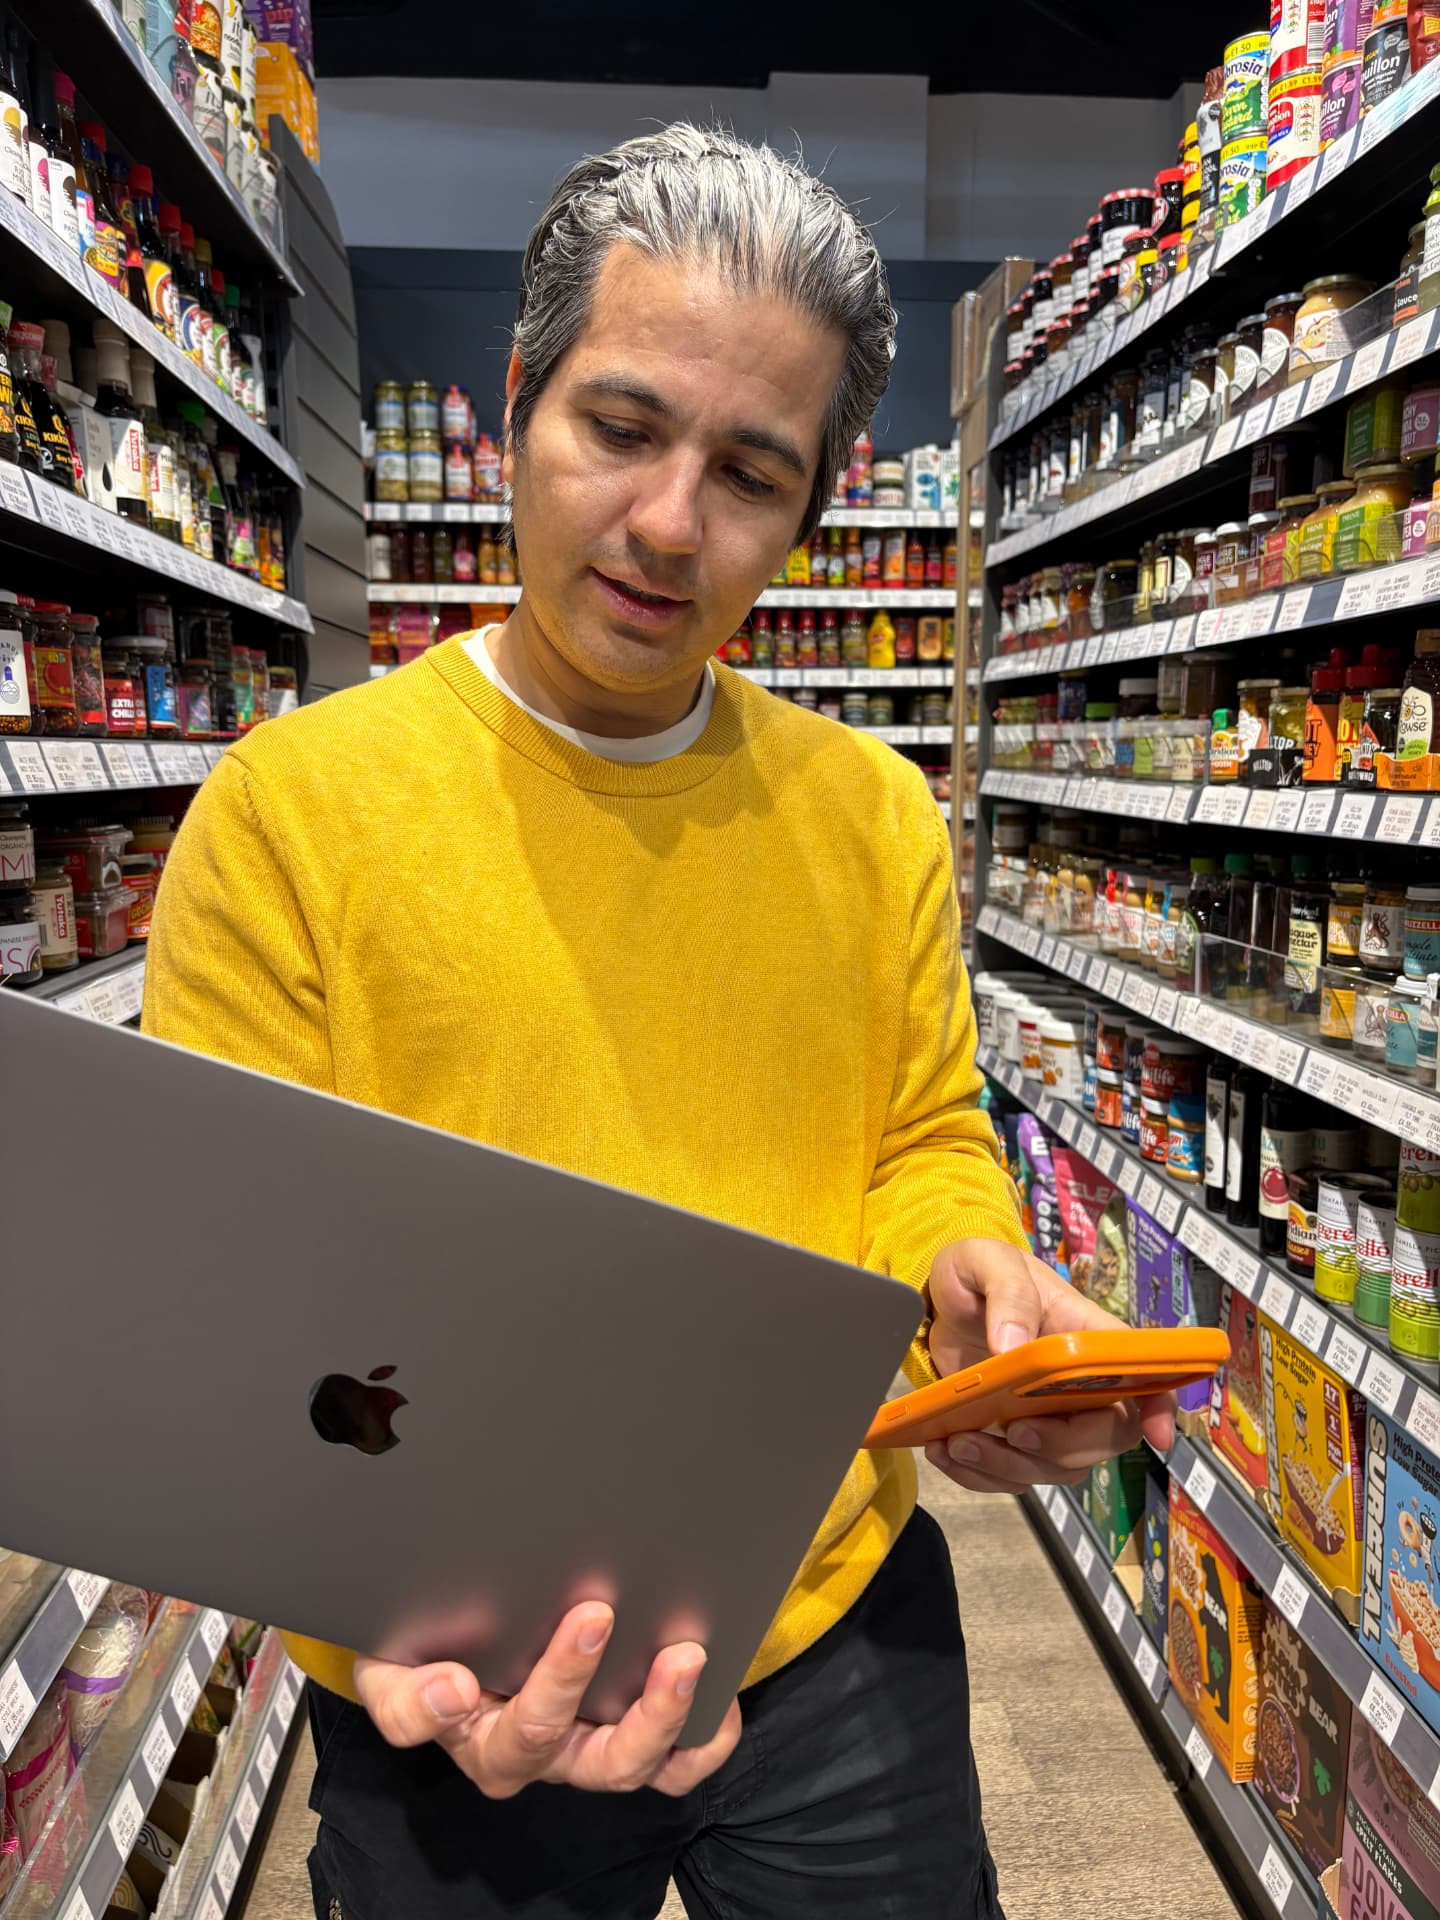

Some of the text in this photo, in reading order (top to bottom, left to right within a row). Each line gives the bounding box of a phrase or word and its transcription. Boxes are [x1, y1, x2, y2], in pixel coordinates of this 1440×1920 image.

[1252, 758, 1273, 772] HILLTOP
[56, 896, 66, 937] Yutaka
[1276, 1335, 1290, 1358] High
[1291, 1349, 1317, 1381] Protein
[1276, 1349, 1310, 1388] Low Sugar
[1393, 1431, 1415, 1459] High
[1392, 1448, 1439, 1497] Low Sugar
[1361, 1414, 1389, 1644] SURREAL
[1384, 1652, 1418, 1697] Frosted
[1308, 1695, 1338, 1743] BEAR
[1356, 1811, 1397, 1872] ANCIENT GRAIN
[1356, 1820, 1403, 1895] SPELT FLAKES
